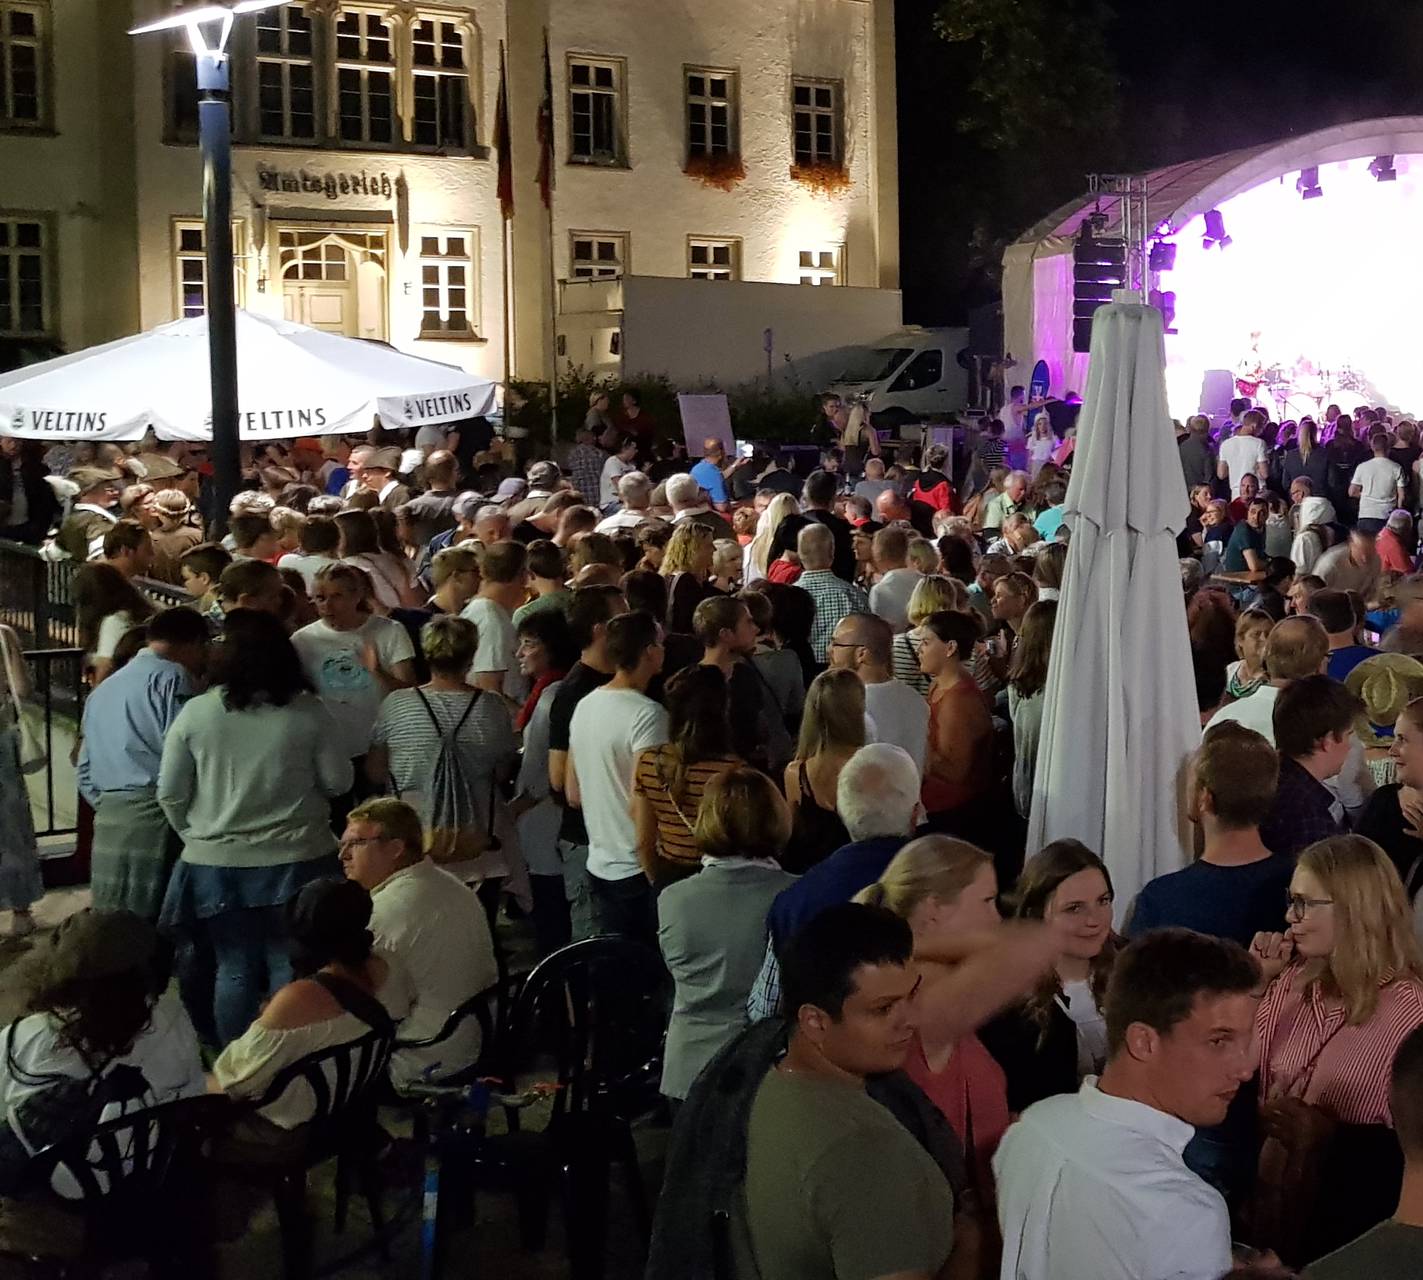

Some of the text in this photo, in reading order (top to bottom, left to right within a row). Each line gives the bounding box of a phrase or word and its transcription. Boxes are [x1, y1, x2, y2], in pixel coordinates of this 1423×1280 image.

[416, 392, 472, 418] VELTINS
[32, 410, 106, 432] VELTINS
[238, 407, 326, 431] ELTINS
